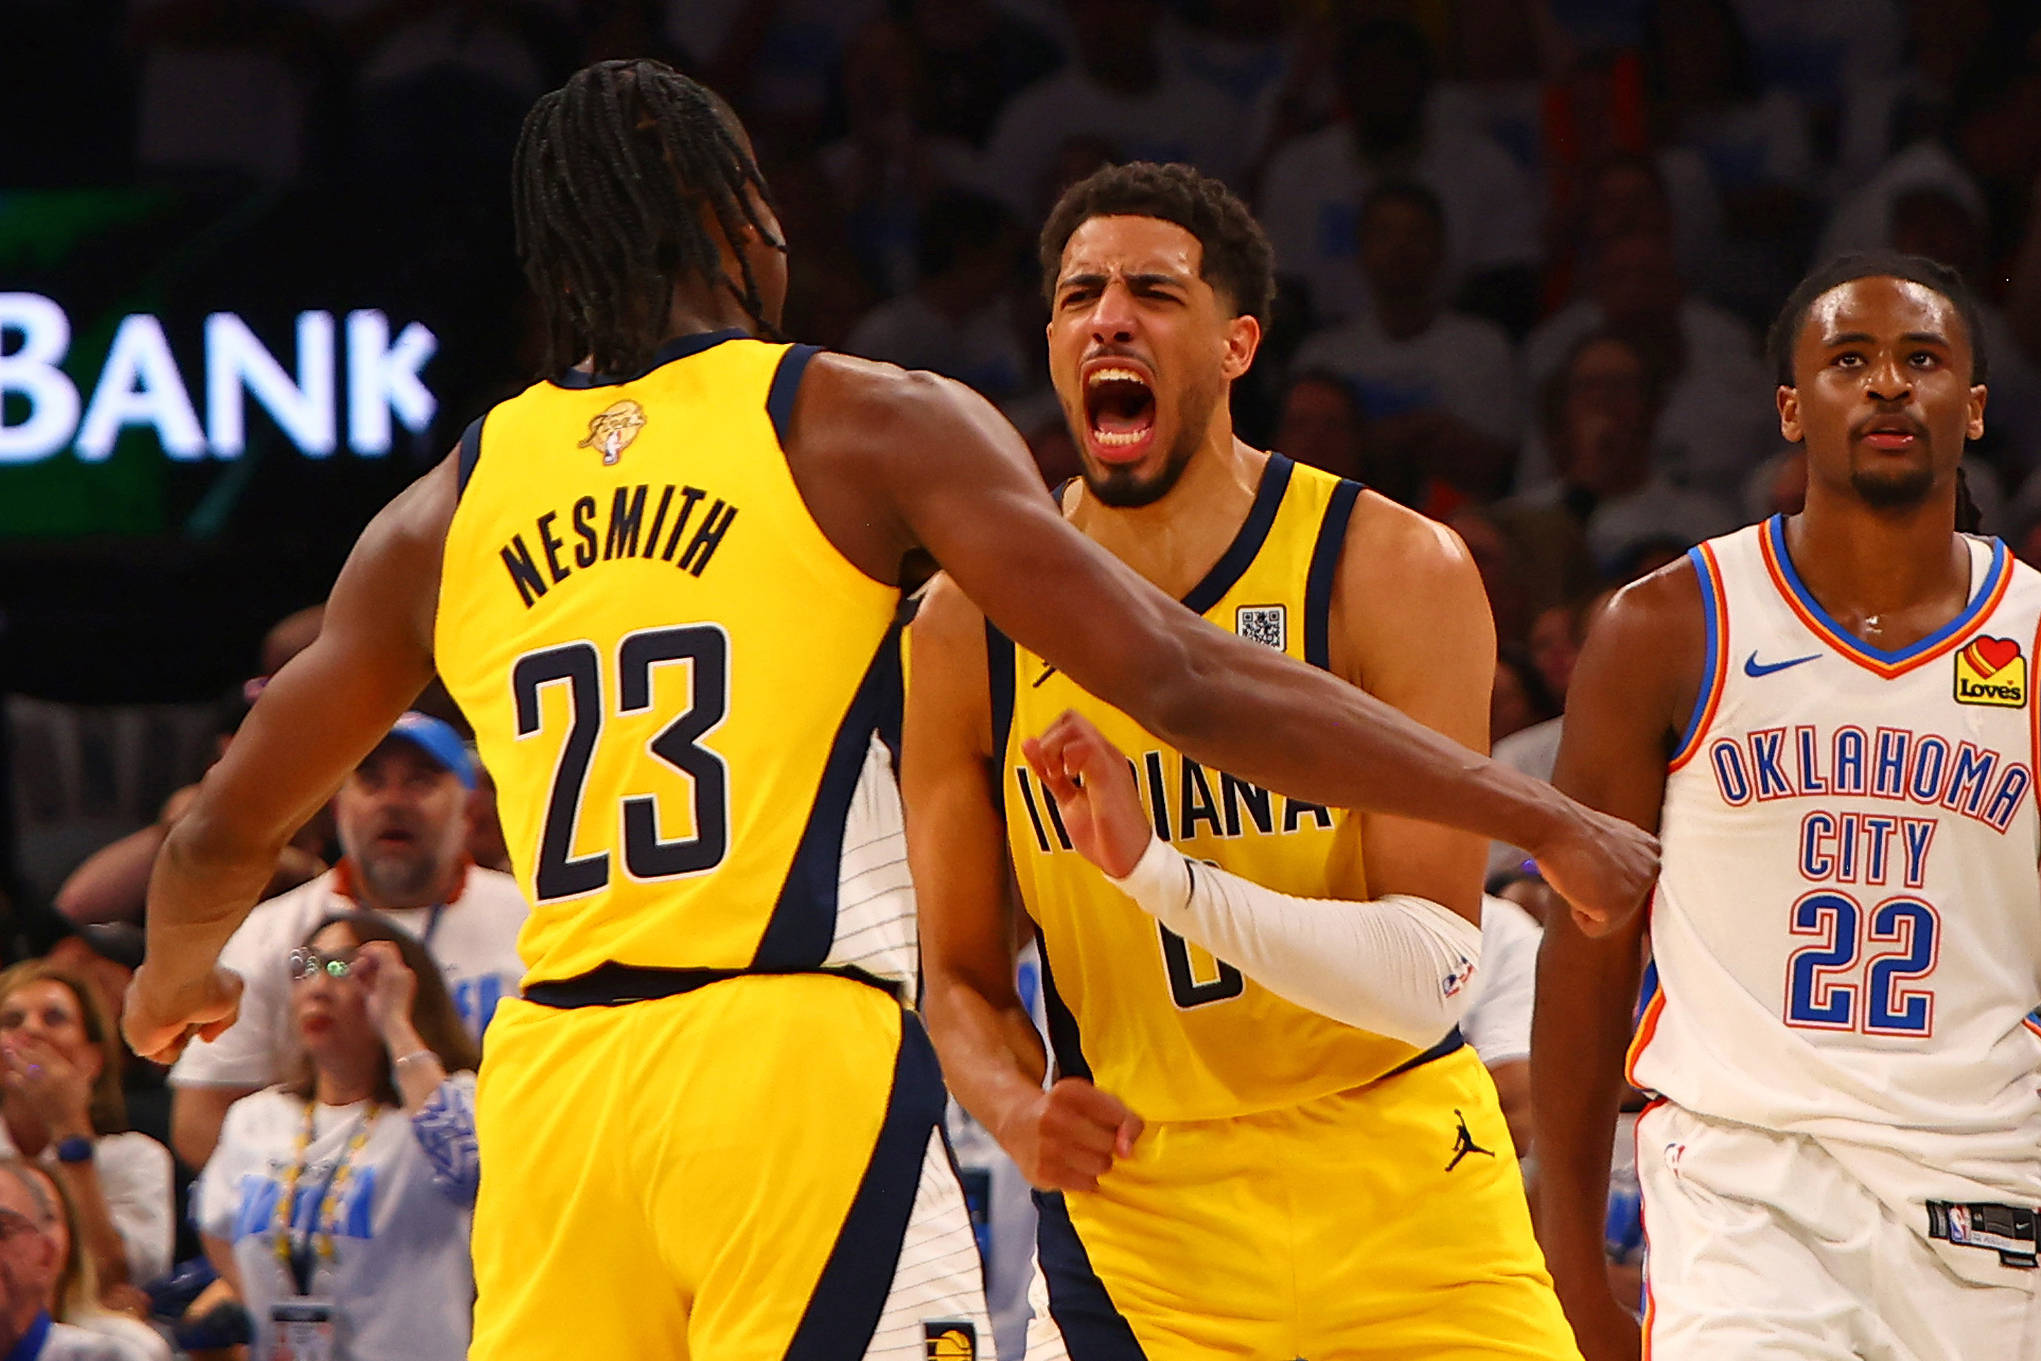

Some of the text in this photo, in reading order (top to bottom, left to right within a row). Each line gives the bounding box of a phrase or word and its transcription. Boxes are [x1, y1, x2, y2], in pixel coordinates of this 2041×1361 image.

[0, 291, 438, 463] BANK
[500, 484, 738, 609] NESMITH
[511, 622, 731, 905] 23
[1014, 750, 1335, 854] IIAN
[1709, 724, 2032, 835] OKLAHOMA
[1799, 809, 1938, 888] CITY
[1783, 888, 1941, 1038] 22
